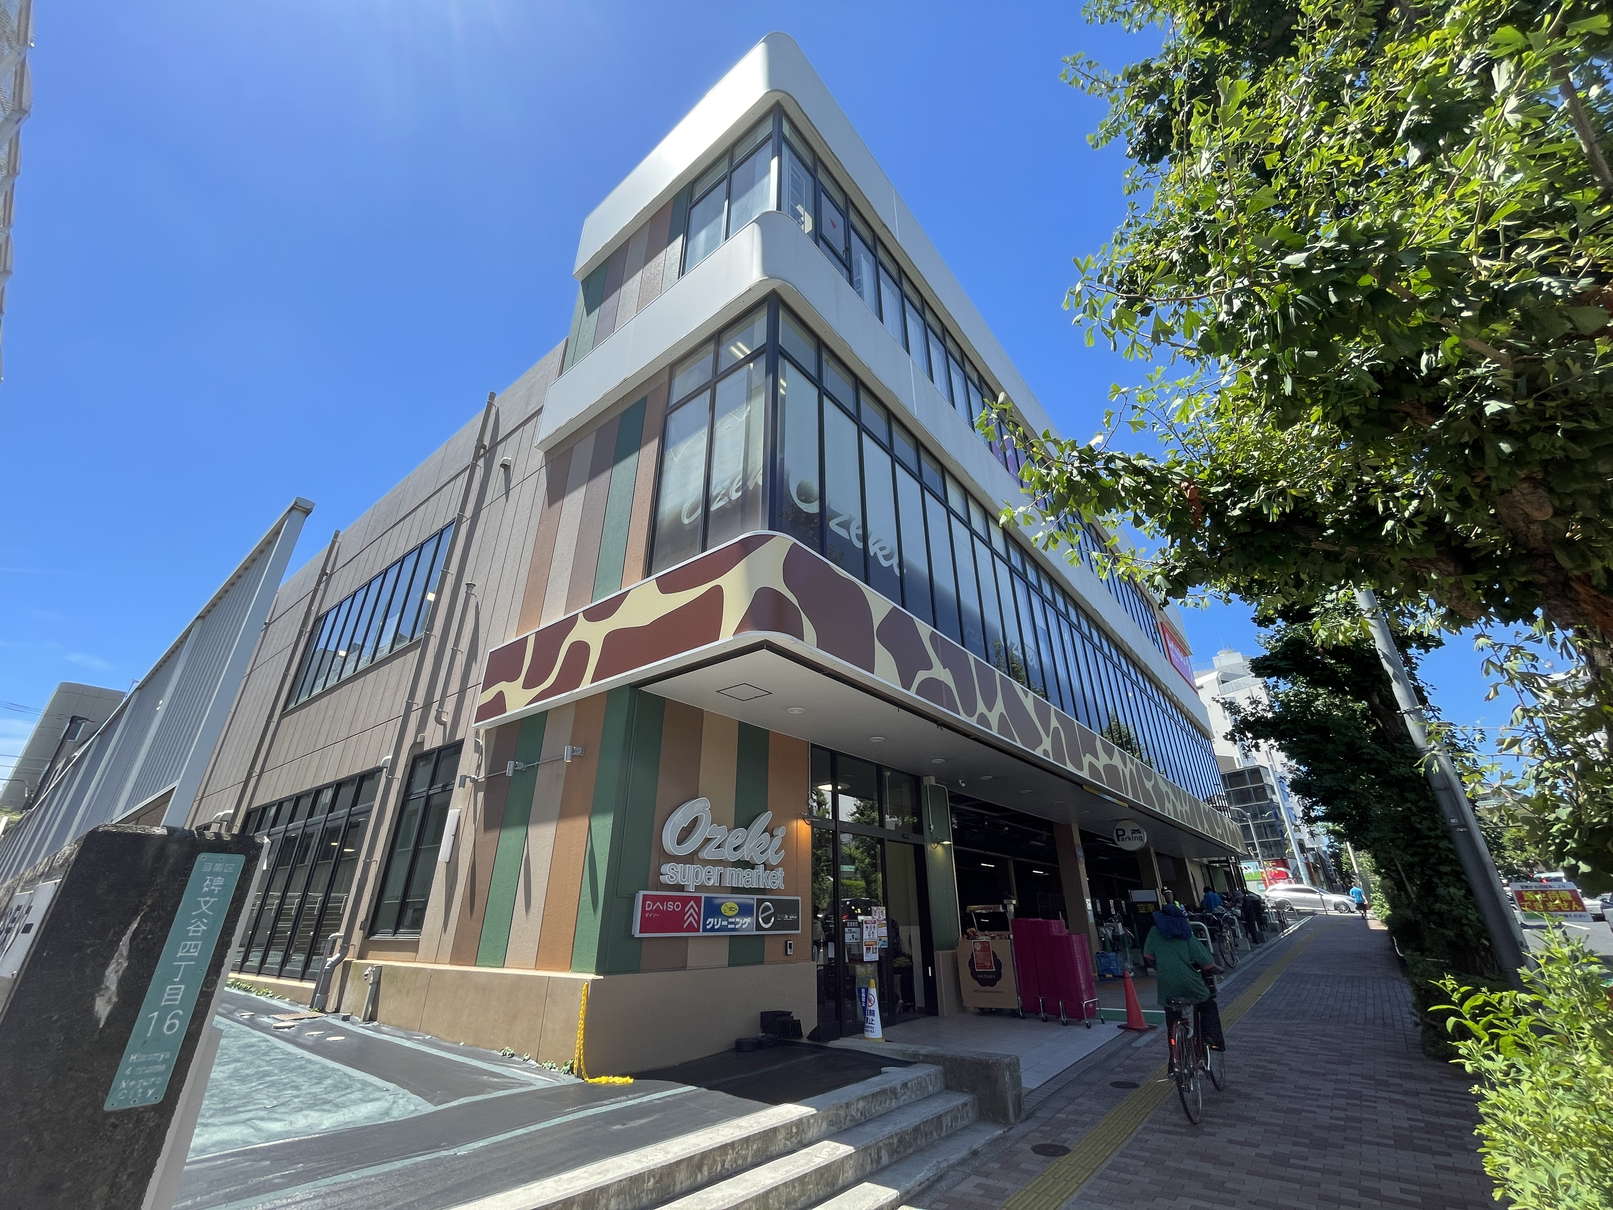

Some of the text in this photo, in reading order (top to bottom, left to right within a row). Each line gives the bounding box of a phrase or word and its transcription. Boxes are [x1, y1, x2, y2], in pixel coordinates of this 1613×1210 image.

[662, 797, 785, 865] Ozeki
[660, 863, 784, 891] super market
[645, 901, 682, 911] DAISO
[706, 917, 751, 929] クリーニング
[161, 876, 225, 1006] 碑文谷四丁目
[147, 1009, 184, 1037] 16
